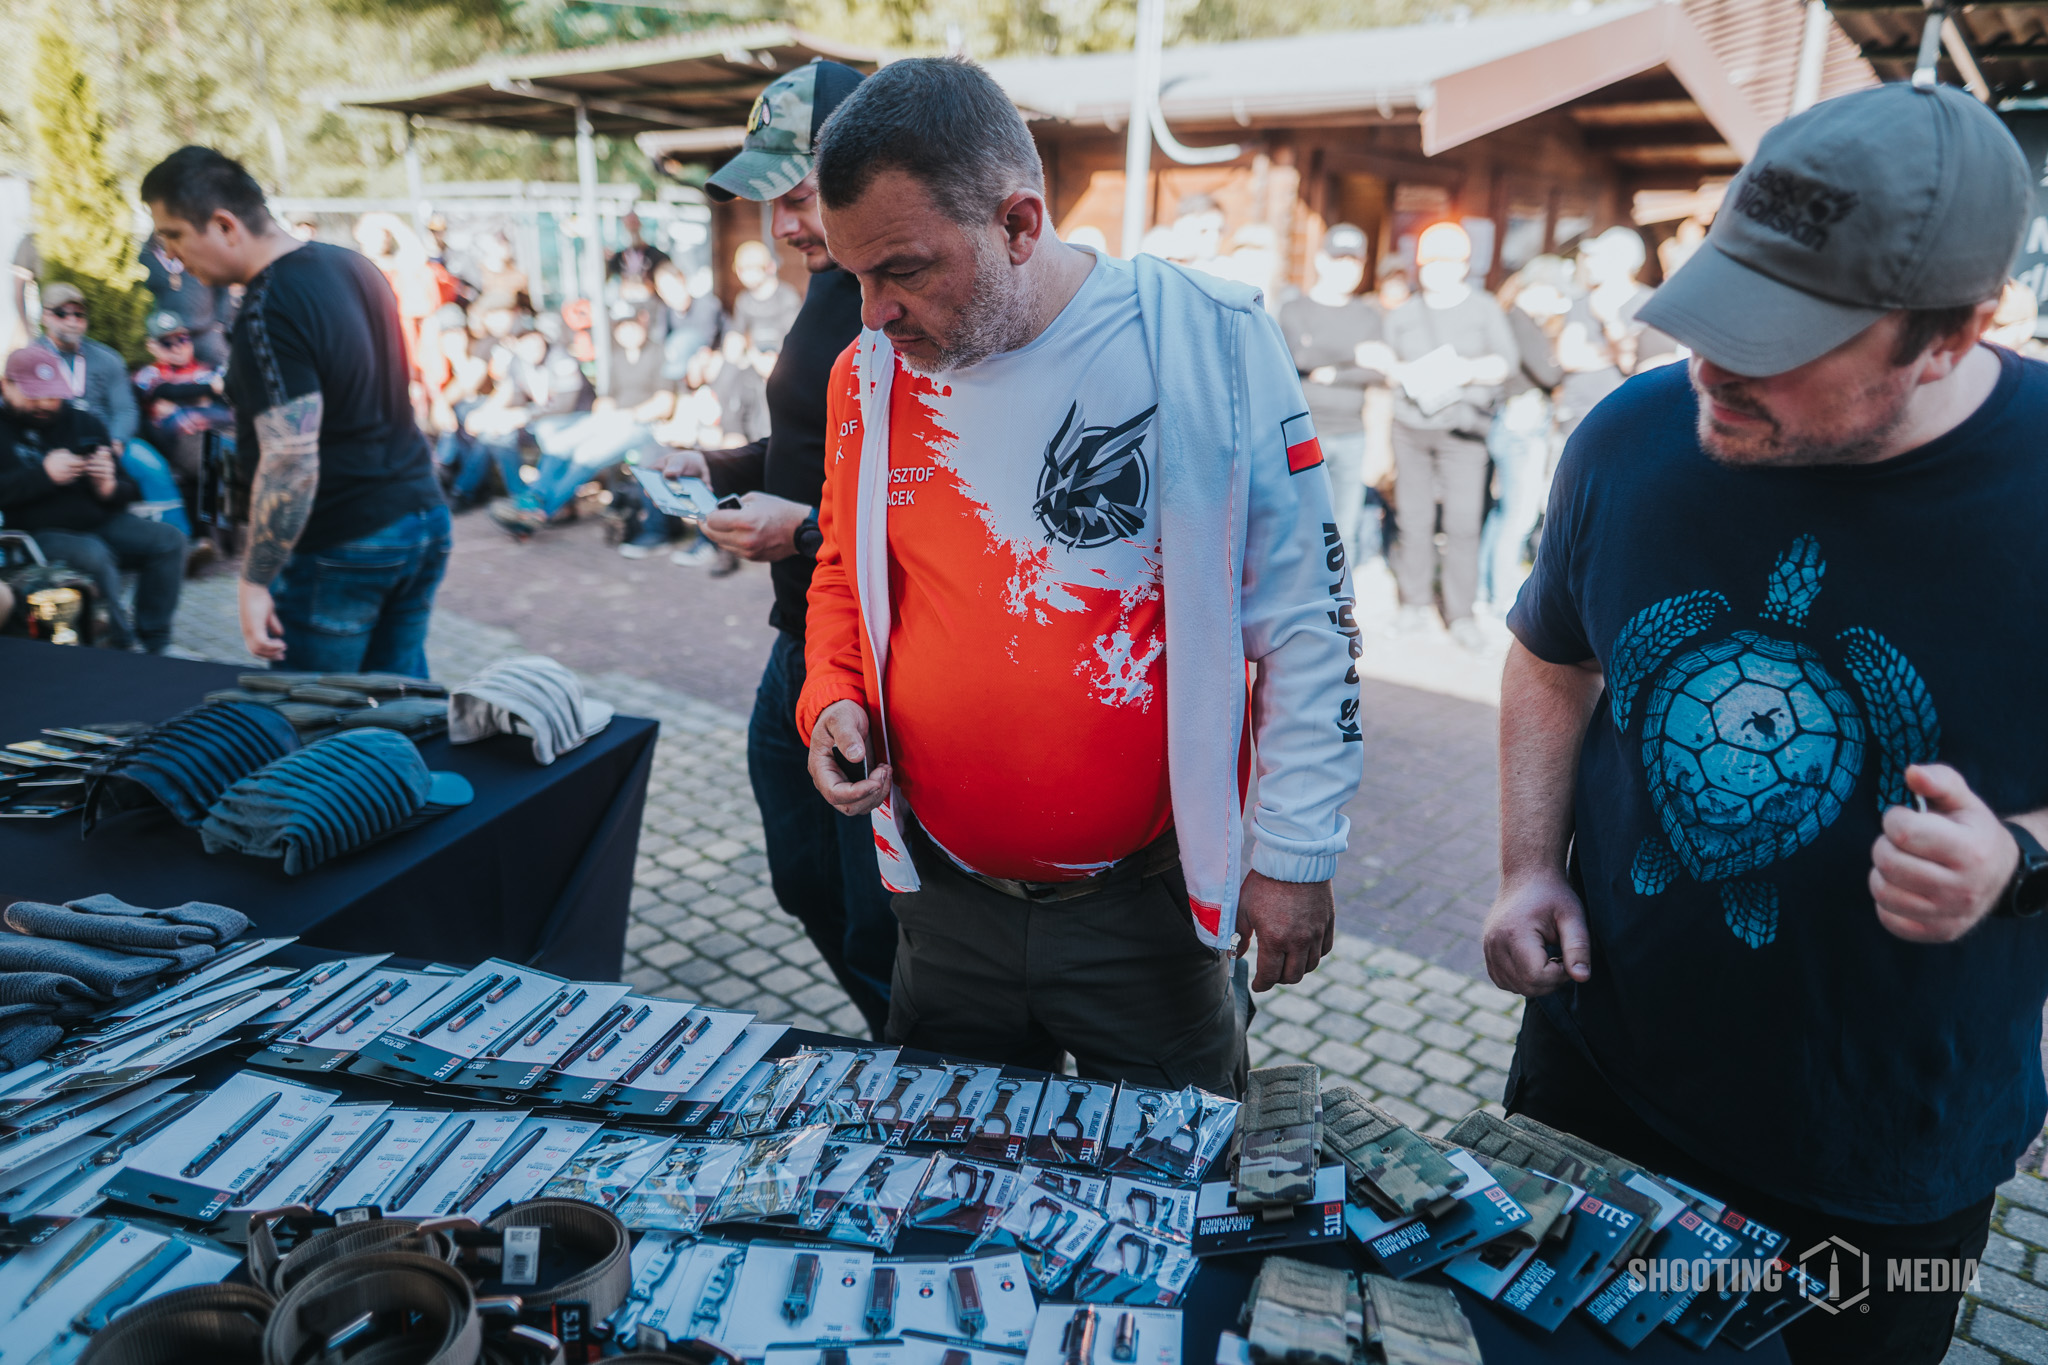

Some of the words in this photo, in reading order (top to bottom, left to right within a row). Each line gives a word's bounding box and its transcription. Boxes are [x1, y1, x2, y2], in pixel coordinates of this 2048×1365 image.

[433, 1064, 454, 1078] 5.11
[519, 1071, 536, 1086] 5.11
[582, 1087, 599, 1100] 5.11
[654, 1100, 671, 1113] 5.11
[1006, 1143, 1020, 1159] 5.11
[1079, 1147, 1094, 1161] 5.11
[200, 1200, 223, 1218] 5.11
[1494, 1198, 1527, 1222] 5.11
[1599, 1203, 1634, 1229] 5.11
[1199, 1225, 1220, 1236] MAG
[1200, 1216, 1229, 1229] POUCH
[1219, 1223, 1231, 1233] AR
[1231, 1222, 1251, 1232] FLEX
[1324, 1213, 1342, 1236] 5.11
[1400, 1221, 1427, 1239] COVER
[1372, 1231, 1402, 1251] POUCH
[1410, 1228, 1430, 1245] FLEX
[1695, 1220, 1733, 1251] 5.11
[1742, 1219, 1781, 1249] 5.11
[1377, 1241, 1402, 1258] MAG
[1523, 1258, 1548, 1281] COVER
[1538, 1267, 1556, 1287] FLEX
[1787, 1265, 1827, 1294] 5.11
[1503, 1276, 1528, 1305] POUCH
[1514, 1291, 1534, 1311] MAG
[1586, 1288, 1612, 1318] POUCH
[1597, 1306, 1618, 1325] MAG
[563, 1309, 580, 1343] 5.11
